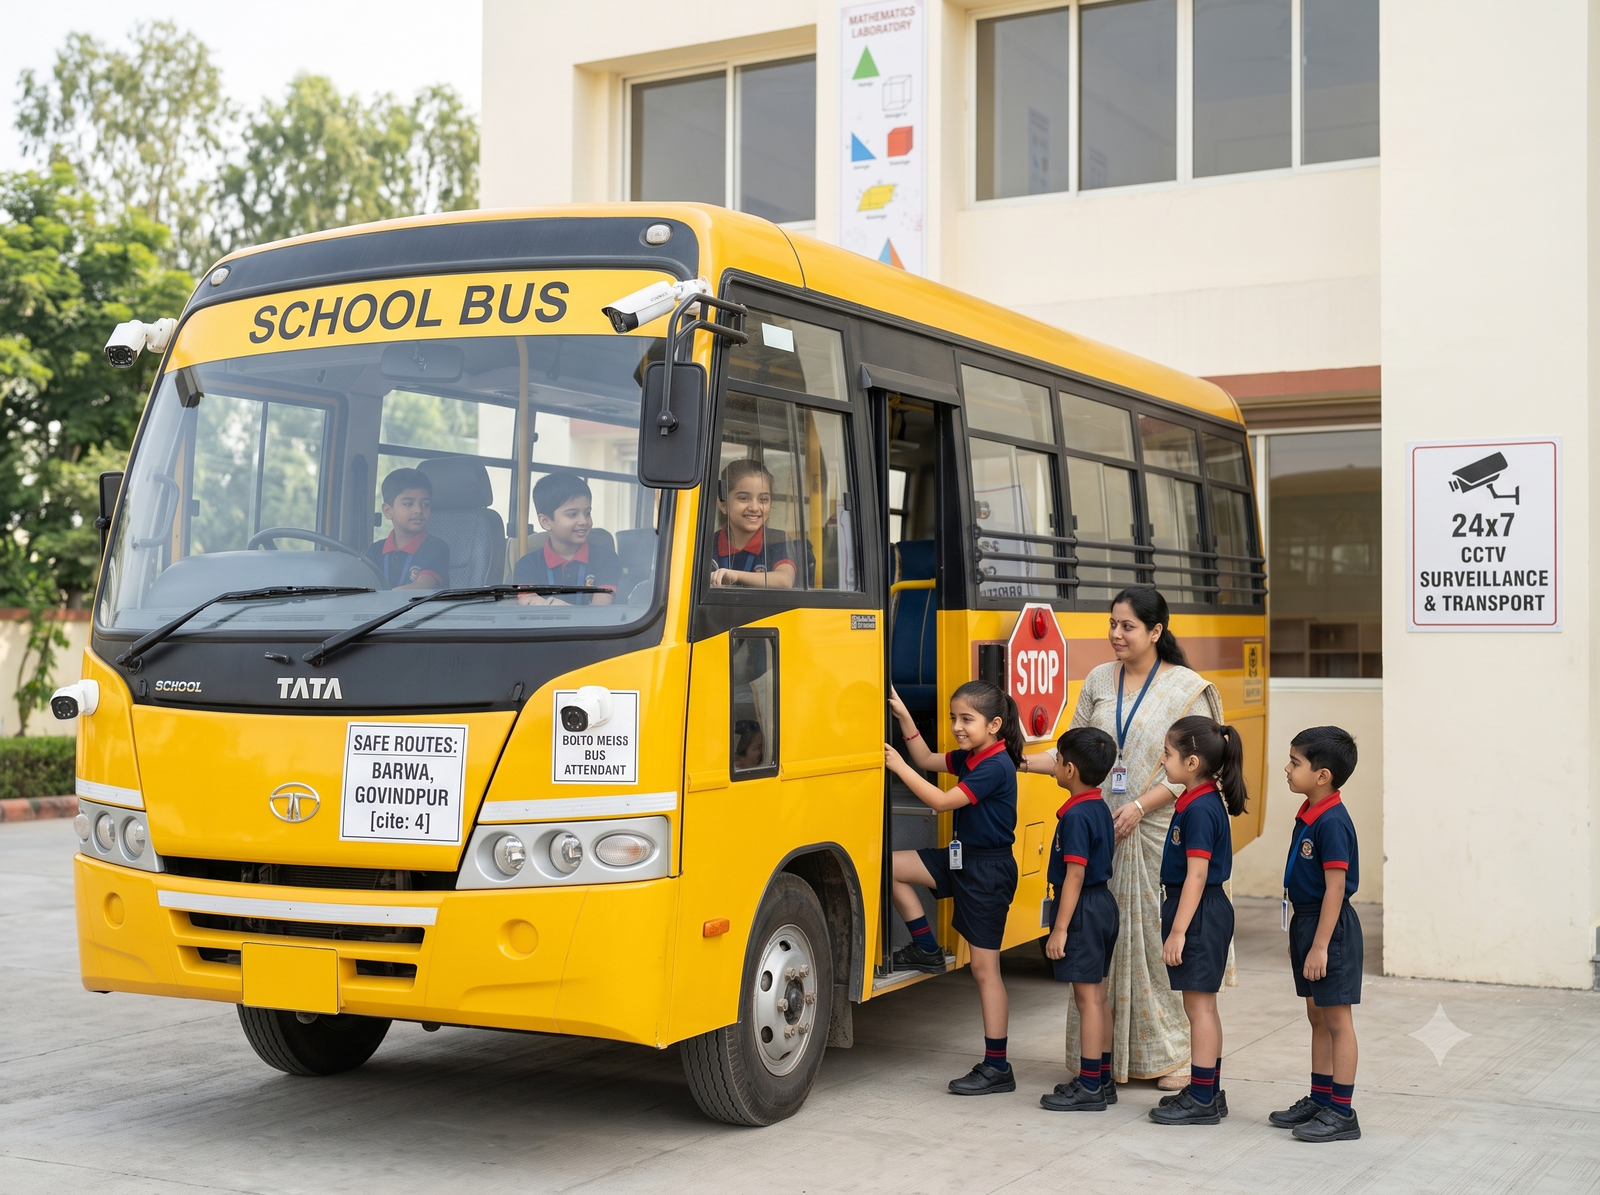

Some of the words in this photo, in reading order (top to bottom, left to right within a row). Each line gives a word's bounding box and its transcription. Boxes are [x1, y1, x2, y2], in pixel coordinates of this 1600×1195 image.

[848, 6, 916, 26] MATHEMATICS
[852, 20, 912, 38] LABORATORY
[249, 288, 443, 344] SCHOOL
[459, 281, 570, 325] BUS
[1452, 512, 1515, 538] 24x7
[1461, 546, 1506, 563] CCTV
[1420, 570, 1549, 588] SURVEILLANCE
[1424, 595, 1437, 611] &
[1442, 594, 1545, 611] TRANSPORT
[1016, 650, 1059, 695] STOP
[155, 680, 202, 693] SCHOOL
[276, 677, 343, 700] TATA
[353, 734, 390, 752] SAFE
[394, 735, 458, 753] ROUTES:
[597, 735, 629, 746] MEISS
[584, 750, 606, 761] BUS
[372, 762, 434, 784] BARWA,
[564, 765, 627, 775] ATTENDANT
[355, 786, 449, 807] GOVINDPUR
[370, 811, 409, 832] [cite:
[415, 812, 431, 834] 4]
